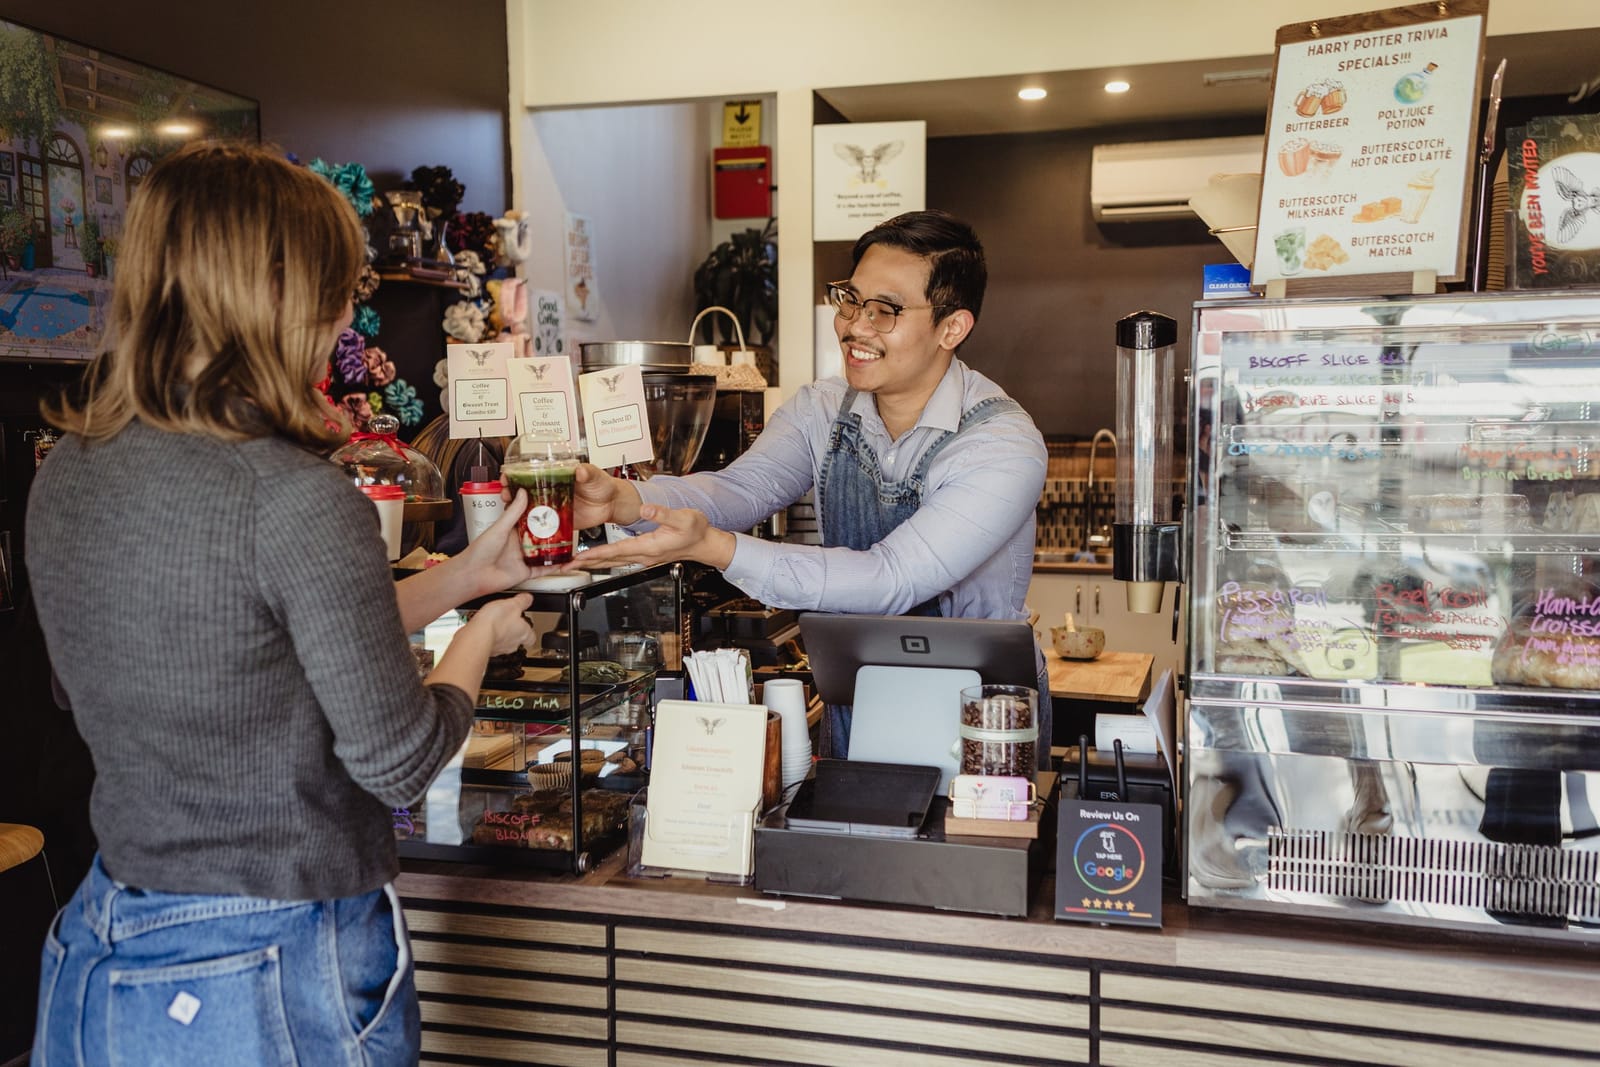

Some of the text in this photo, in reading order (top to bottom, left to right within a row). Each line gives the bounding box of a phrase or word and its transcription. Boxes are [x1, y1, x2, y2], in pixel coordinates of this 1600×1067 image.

[1307, 27, 1449, 57] HARRY POTTER TRIVIA
[1338, 52, 1412, 72] SPECIALS!!!
[1285, 118, 1350, 133] BUTTERBEER
[1386, 118, 1426, 131] POTION
[1361, 138, 1445, 155] BUTTERSCOTCH
[1351, 149, 1452, 168] HOT OR ICED LATTE
[1522, 138, 1541, 190] INVITED
[1279, 193, 1357, 209] BUTTERSCOTCH
[1287, 206, 1345, 220] MILKSHAKE
[1527, 194, 1543, 230] BEEN
[1351, 232, 1435, 247] BUTTERSCOTCH
[1369, 246, 1413, 258] MATCHA
[538, 296, 558, 312] Good
[1249, 353, 1311, 369] BISCOFF
[1322, 353, 1370, 366] SLICE
[1300, 394, 1330, 406] RIPE
[1336, 394, 1378, 406] SLICE
[1462, 465, 1573, 482] Banana Bread
[1289, 588, 1328, 609] Roll
[1376, 581, 1433, 612] Beef
[483, 809, 541, 826] BISCOFF
[1079, 808, 1140, 822] Review Us On
[1084, 861, 1133, 881] Google
